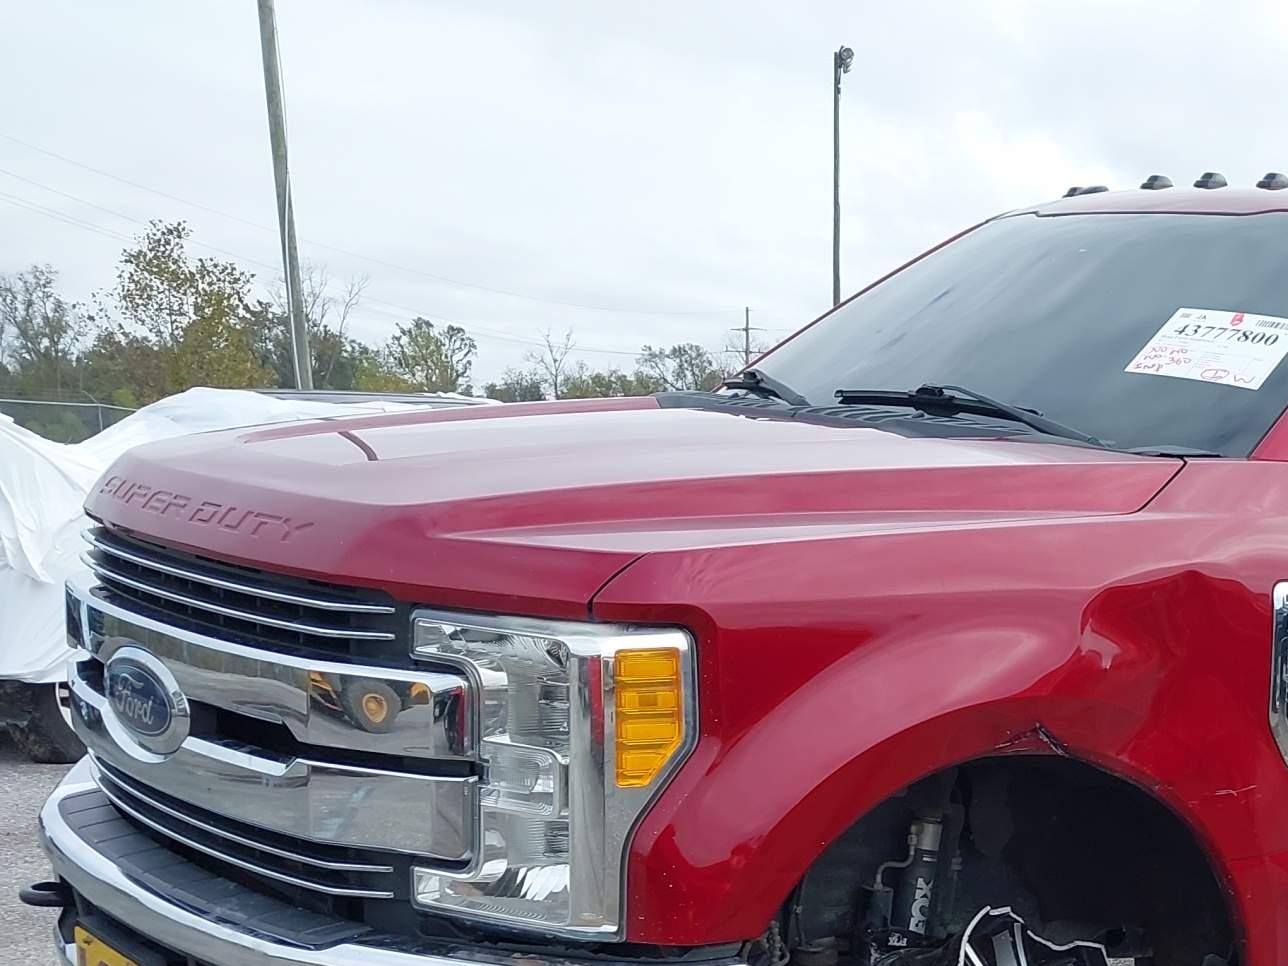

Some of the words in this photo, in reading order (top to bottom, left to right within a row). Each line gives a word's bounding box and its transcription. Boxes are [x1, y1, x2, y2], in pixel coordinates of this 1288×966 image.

[1173, 323, 1280, 347] 43777800
[98, 475, 192, 515] SUPER
[187, 500, 315, 544] DUTY
[114, 672, 155, 725] Ford
